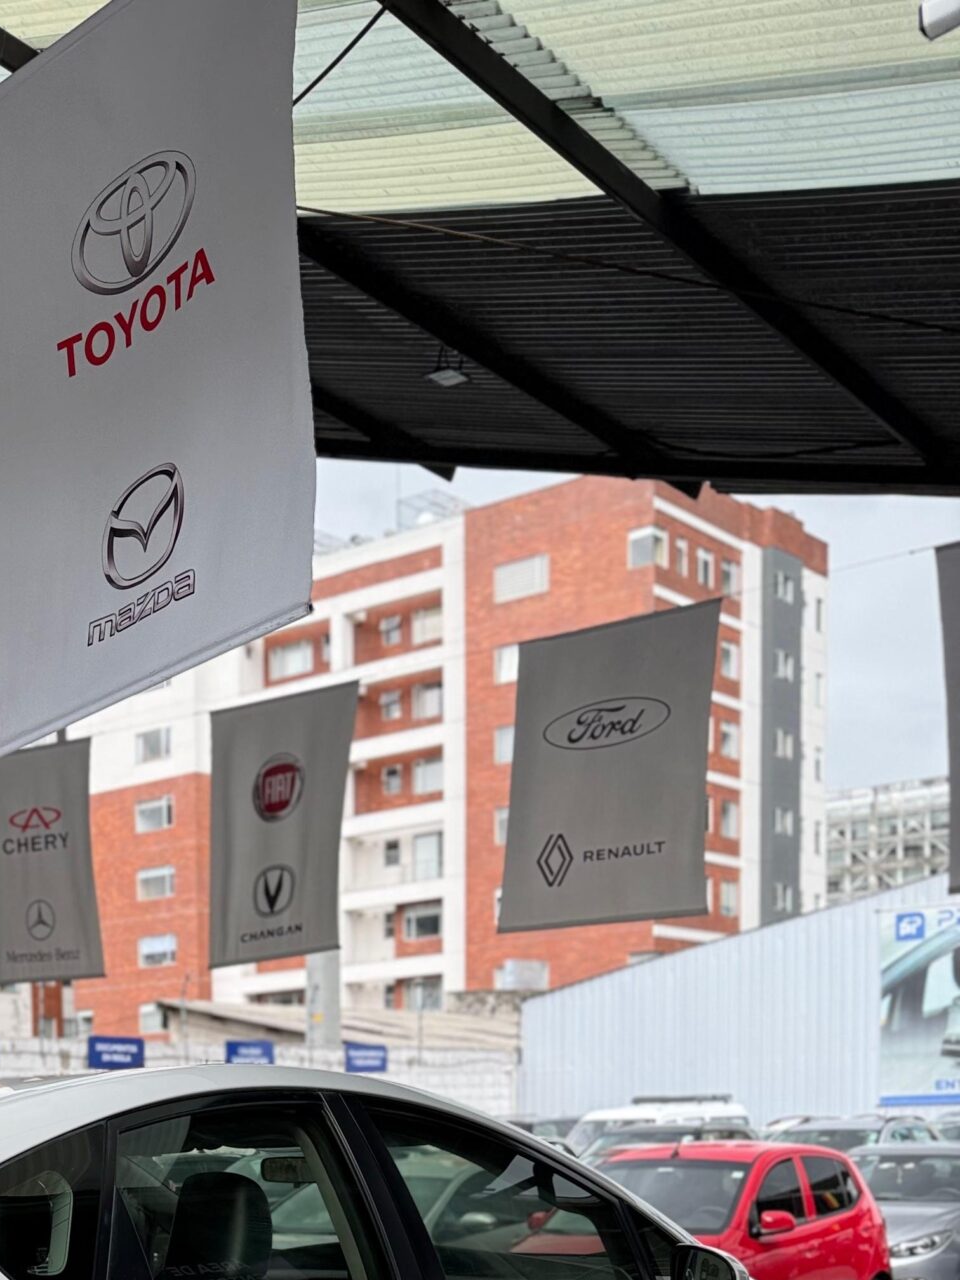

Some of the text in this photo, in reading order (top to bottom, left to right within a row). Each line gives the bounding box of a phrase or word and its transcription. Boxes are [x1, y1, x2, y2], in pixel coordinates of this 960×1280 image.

[57, 247, 215, 378] TOYOTA
[87, 568, 196, 647] mazda
[567, 704, 645, 744] Ford
[265, 771, 294, 803] FIAT
[2, 832, 70, 855] CHERY
[583, 840, 666, 863] RENAULT
[240, 923, 303, 943] CHANGAN
